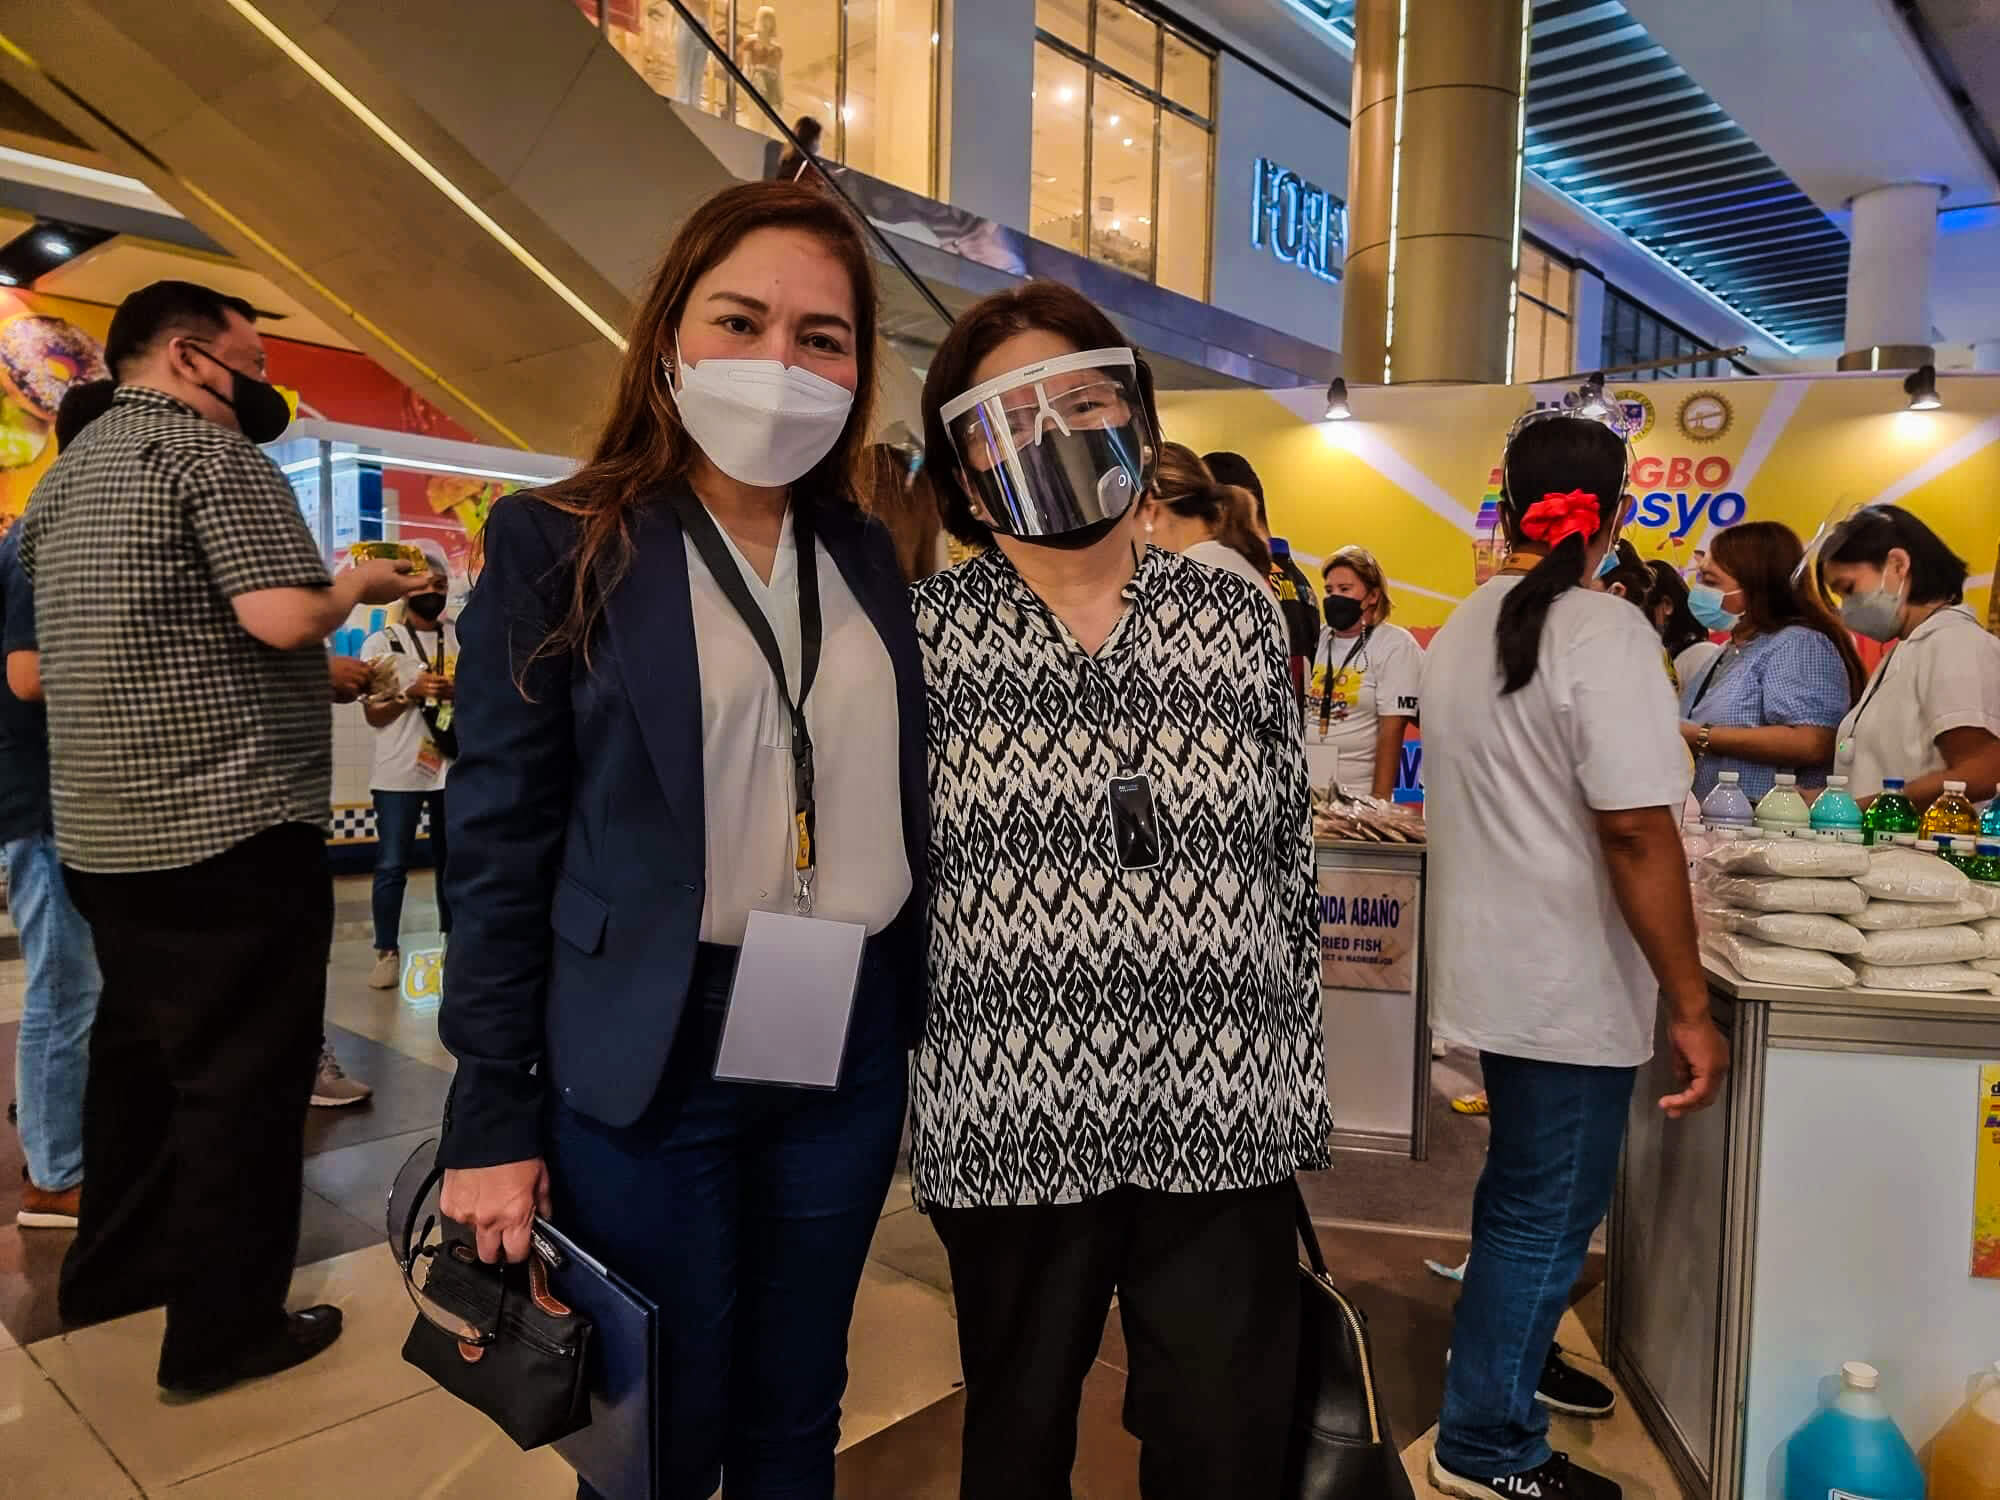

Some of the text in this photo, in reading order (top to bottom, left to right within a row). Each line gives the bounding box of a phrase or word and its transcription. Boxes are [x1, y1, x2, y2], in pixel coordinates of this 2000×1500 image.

[1630, 456, 1731, 489] GBO
[1320, 893, 1400, 928] NDA ABAÑO
[1321, 935, 1382, 952] RIED FISH
[1492, 1475, 1542, 1497] FILA
